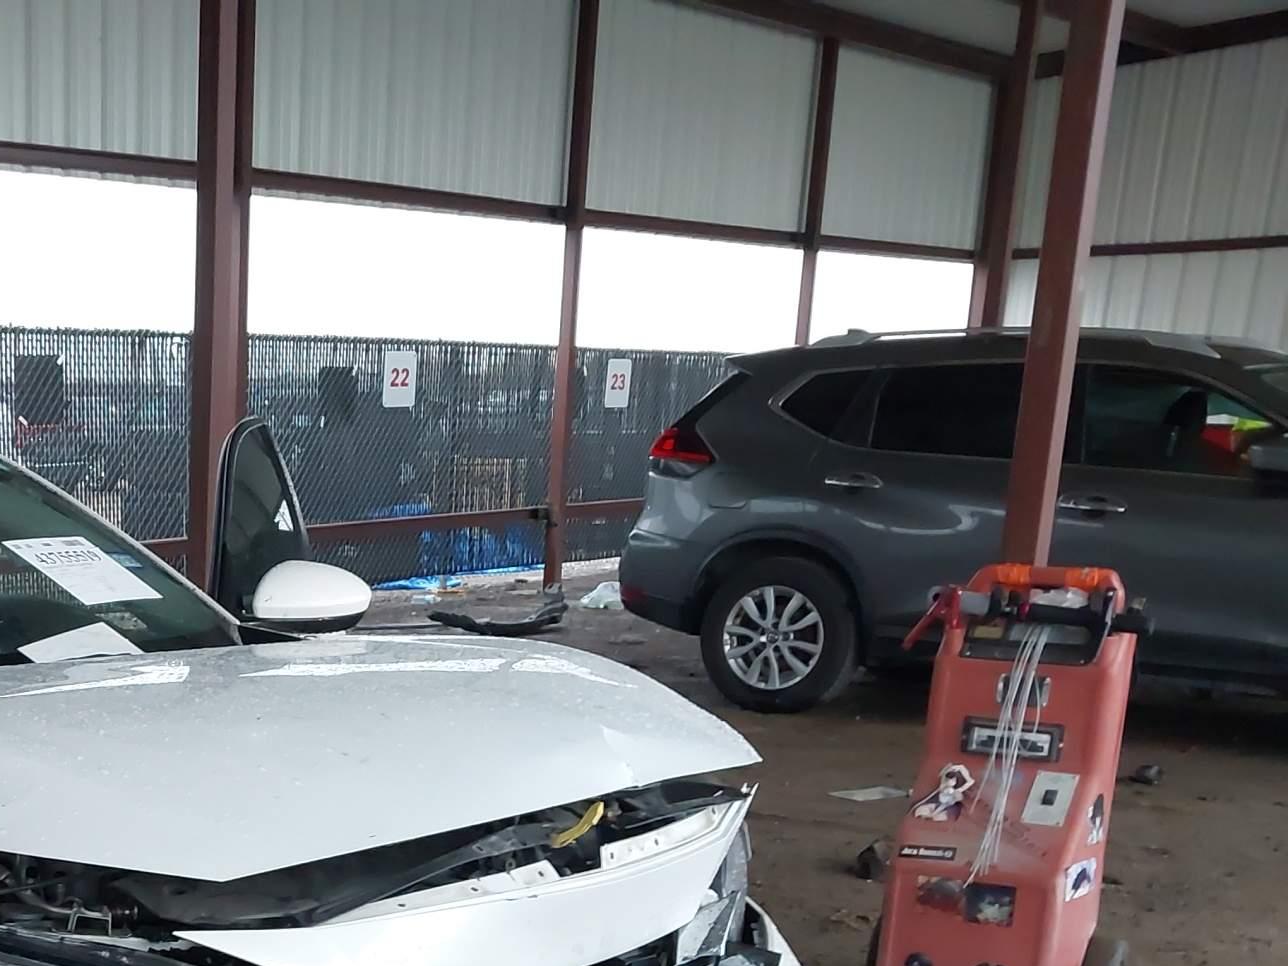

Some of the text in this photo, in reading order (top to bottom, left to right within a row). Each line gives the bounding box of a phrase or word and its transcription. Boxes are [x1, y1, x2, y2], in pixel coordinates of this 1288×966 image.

[390, 367, 410, 387] 22
[610, 373, 626, 390] 23
[34, 549, 102, 566] 43755519
